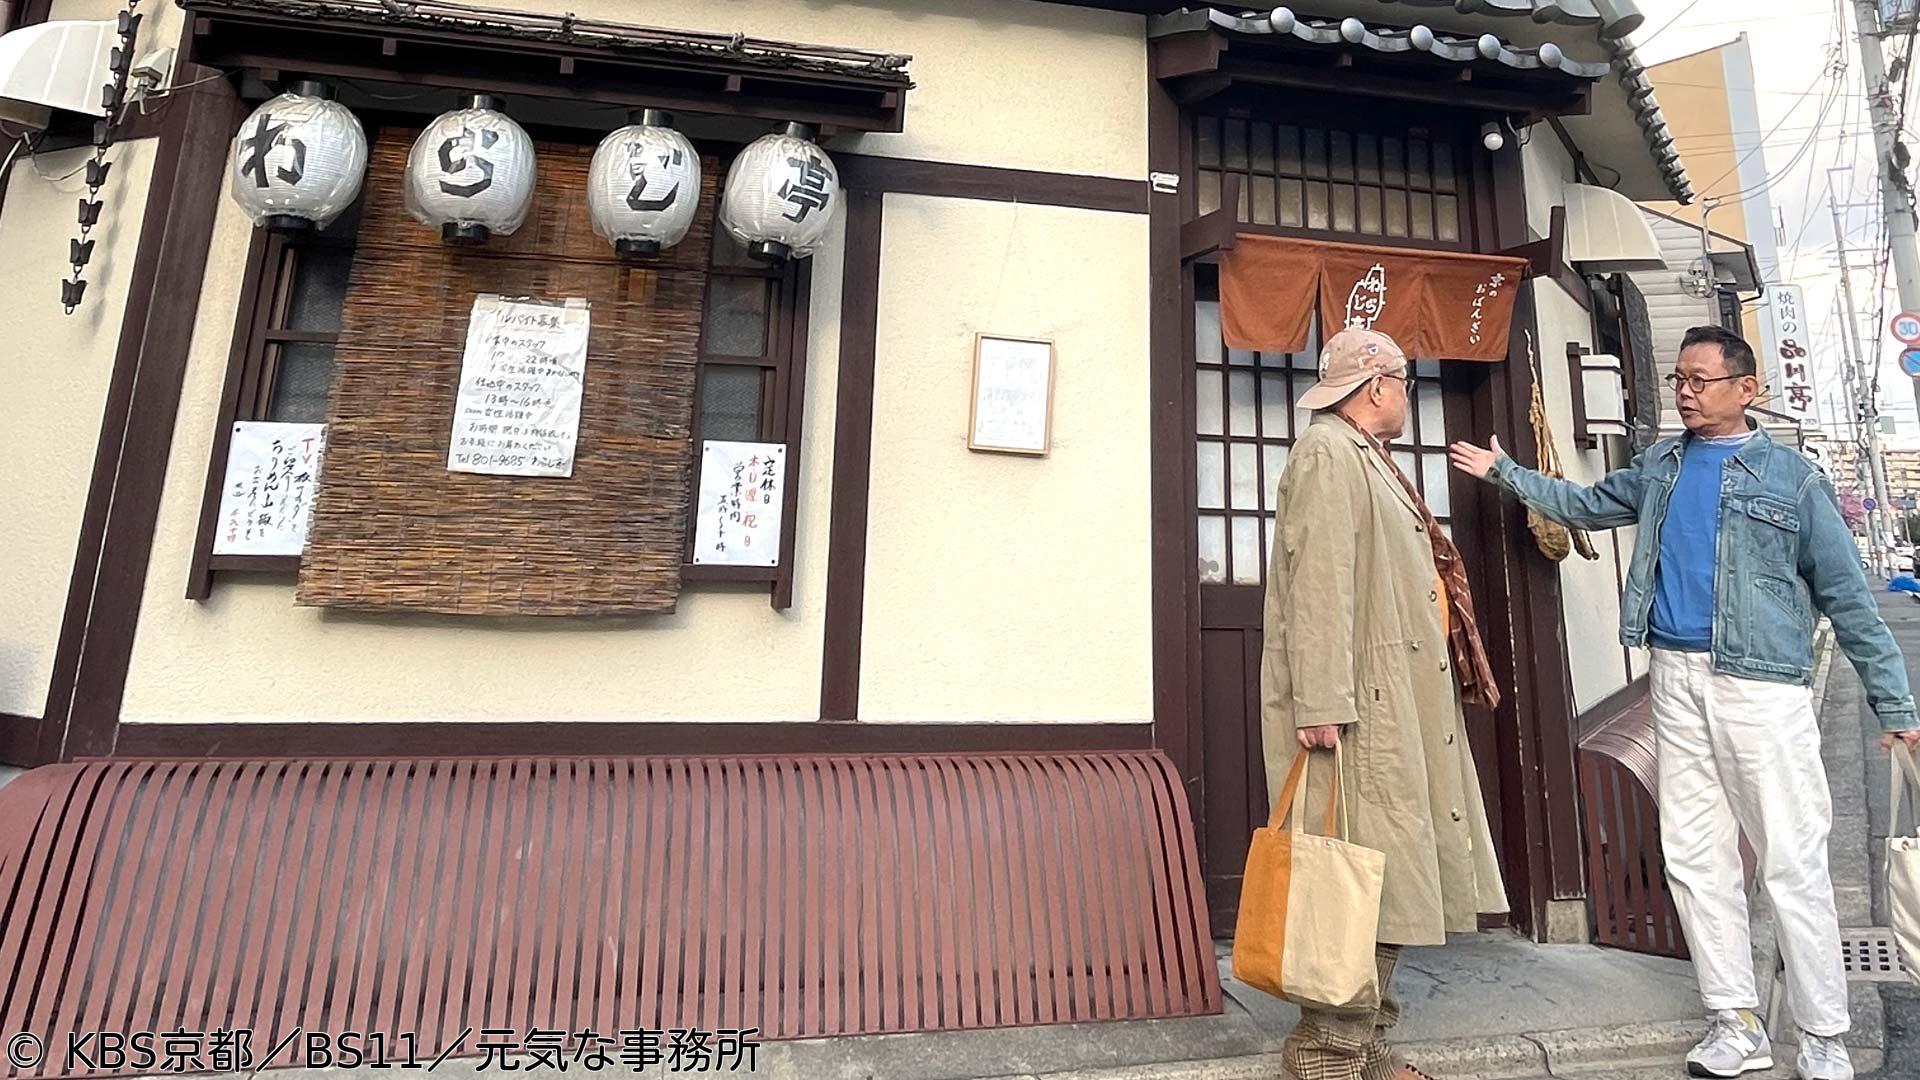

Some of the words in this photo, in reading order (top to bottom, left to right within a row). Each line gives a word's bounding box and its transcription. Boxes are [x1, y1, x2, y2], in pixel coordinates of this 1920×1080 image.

[1898, 321, 1919, 336] 30
[760, 455, 777, 505] 定休日
